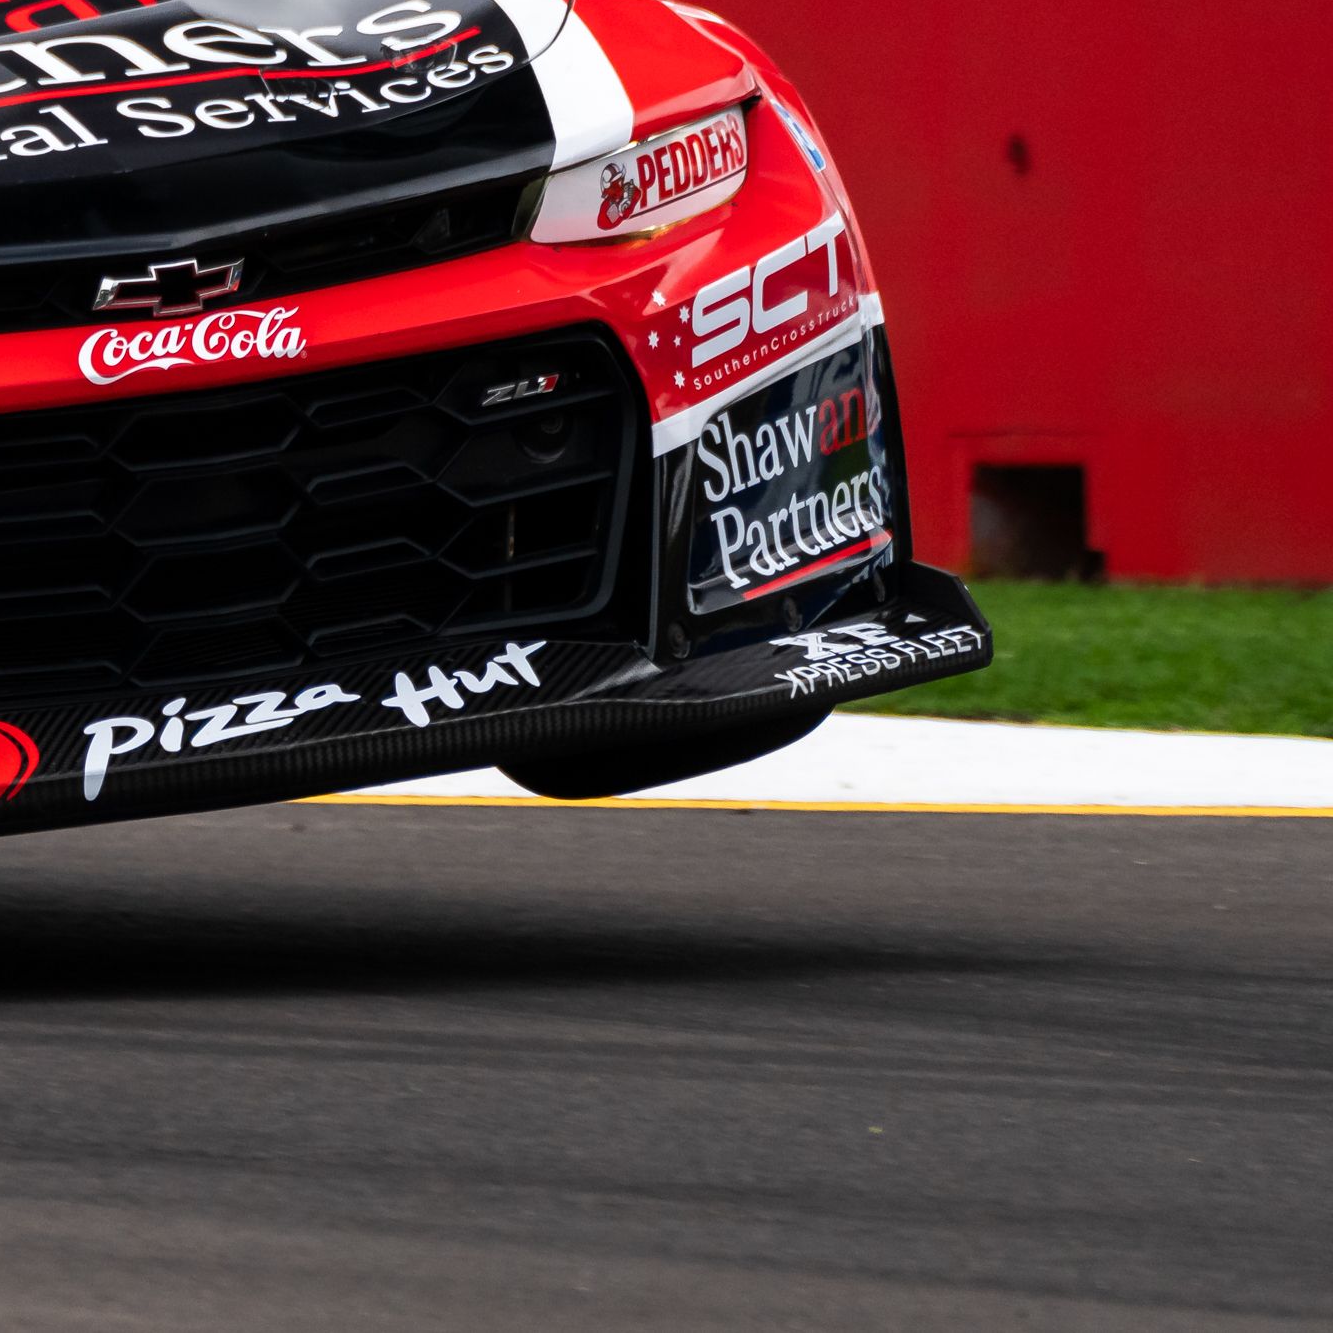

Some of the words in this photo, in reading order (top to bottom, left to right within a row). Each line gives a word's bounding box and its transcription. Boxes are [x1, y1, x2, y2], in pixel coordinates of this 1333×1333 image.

[115, 39, 516, 139] Services
[635, 111, 746, 211] PEDDERS
[710, 465, 884, 590] Partners
[381, 640, 548, 728] Hut
[774, 639, 902, 700] XPRESS
[900, 624, 984, 670] FLEET
